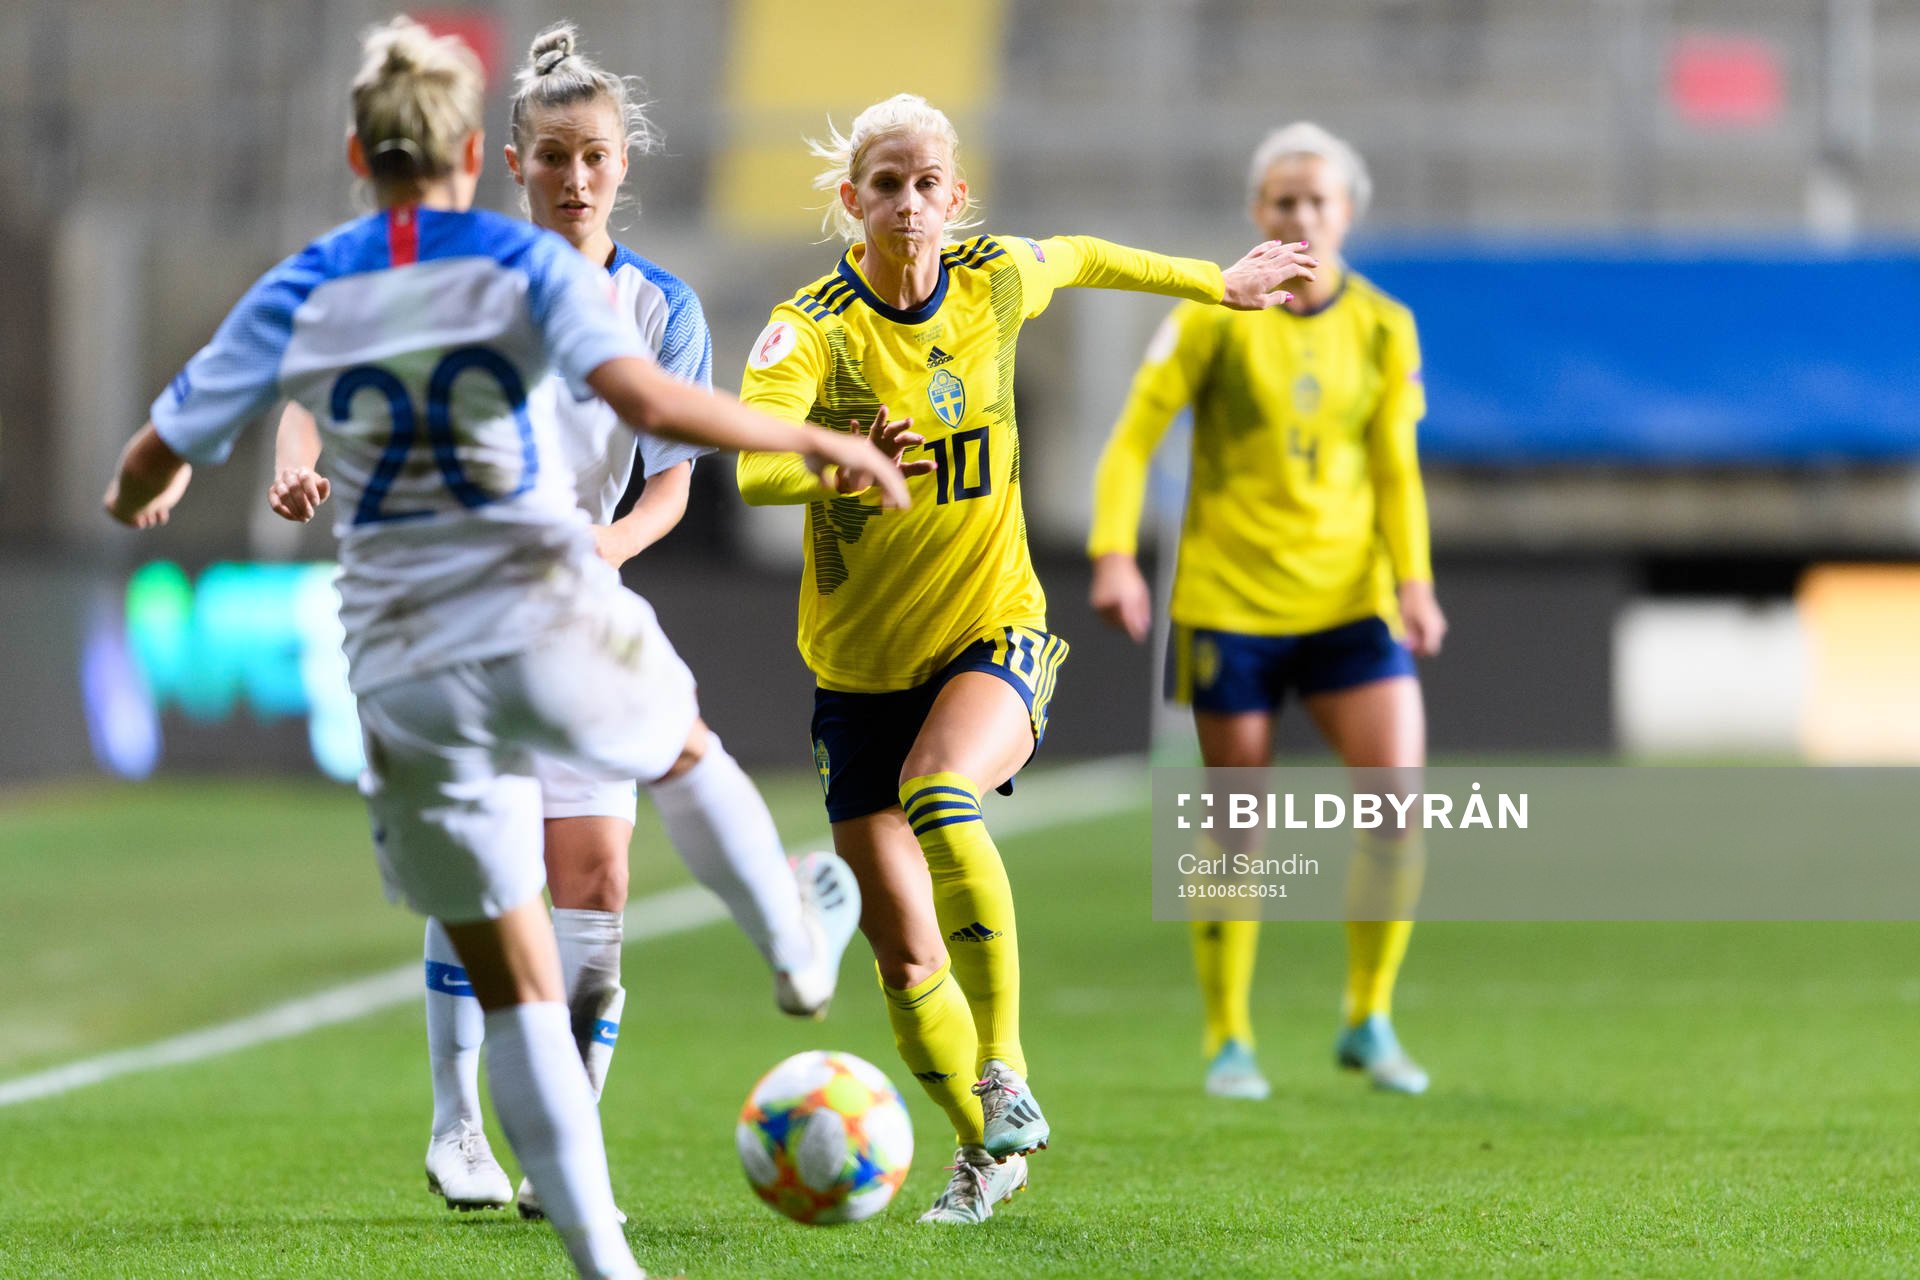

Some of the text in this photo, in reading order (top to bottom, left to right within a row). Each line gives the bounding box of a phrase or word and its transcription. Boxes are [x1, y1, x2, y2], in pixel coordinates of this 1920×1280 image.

[927, 354, 954, 368] adidas
[331, 343, 538, 525] 20
[924, 425, 992, 506] 10
[1288, 425, 1320, 482] 4
[982, 626, 1046, 695] 10
